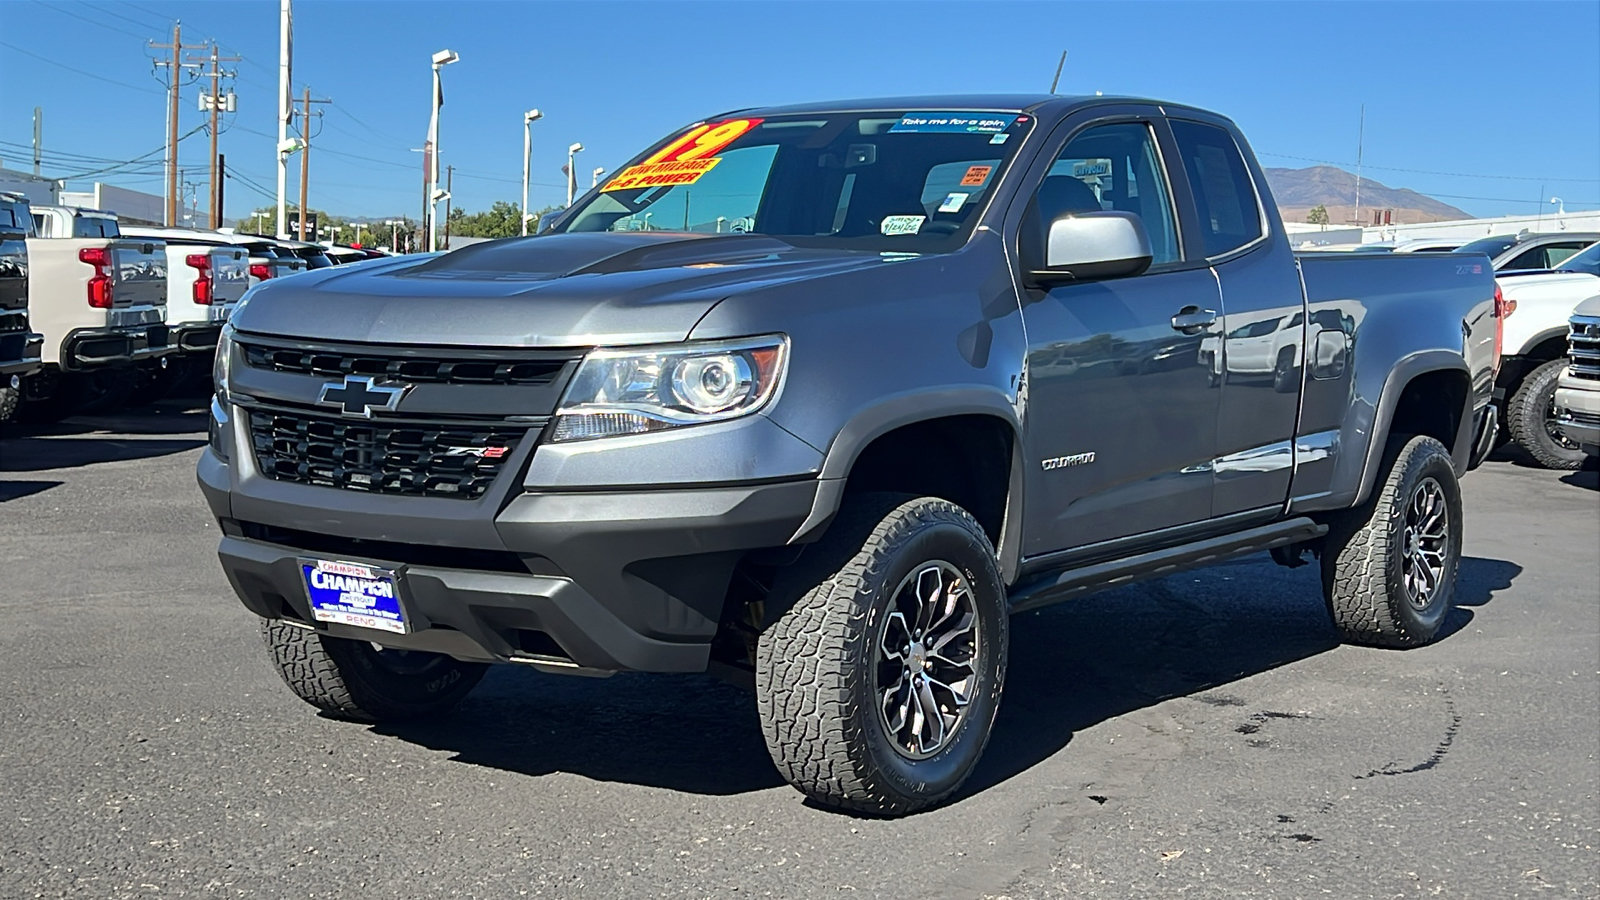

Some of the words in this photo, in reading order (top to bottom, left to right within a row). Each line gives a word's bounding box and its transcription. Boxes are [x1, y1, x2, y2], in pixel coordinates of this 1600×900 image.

[643, 119, 750, 165] 19
[652, 159, 716, 173] MILEAGE
[635, 172, 702, 186] POWER
[446, 446, 509, 458] ZR2
[1041, 452, 1096, 470] COLORADO
[322, 563, 367, 576] CHAMPION
[310, 568, 393, 598] CHAMPION
[346, 615, 376, 627] RENO
